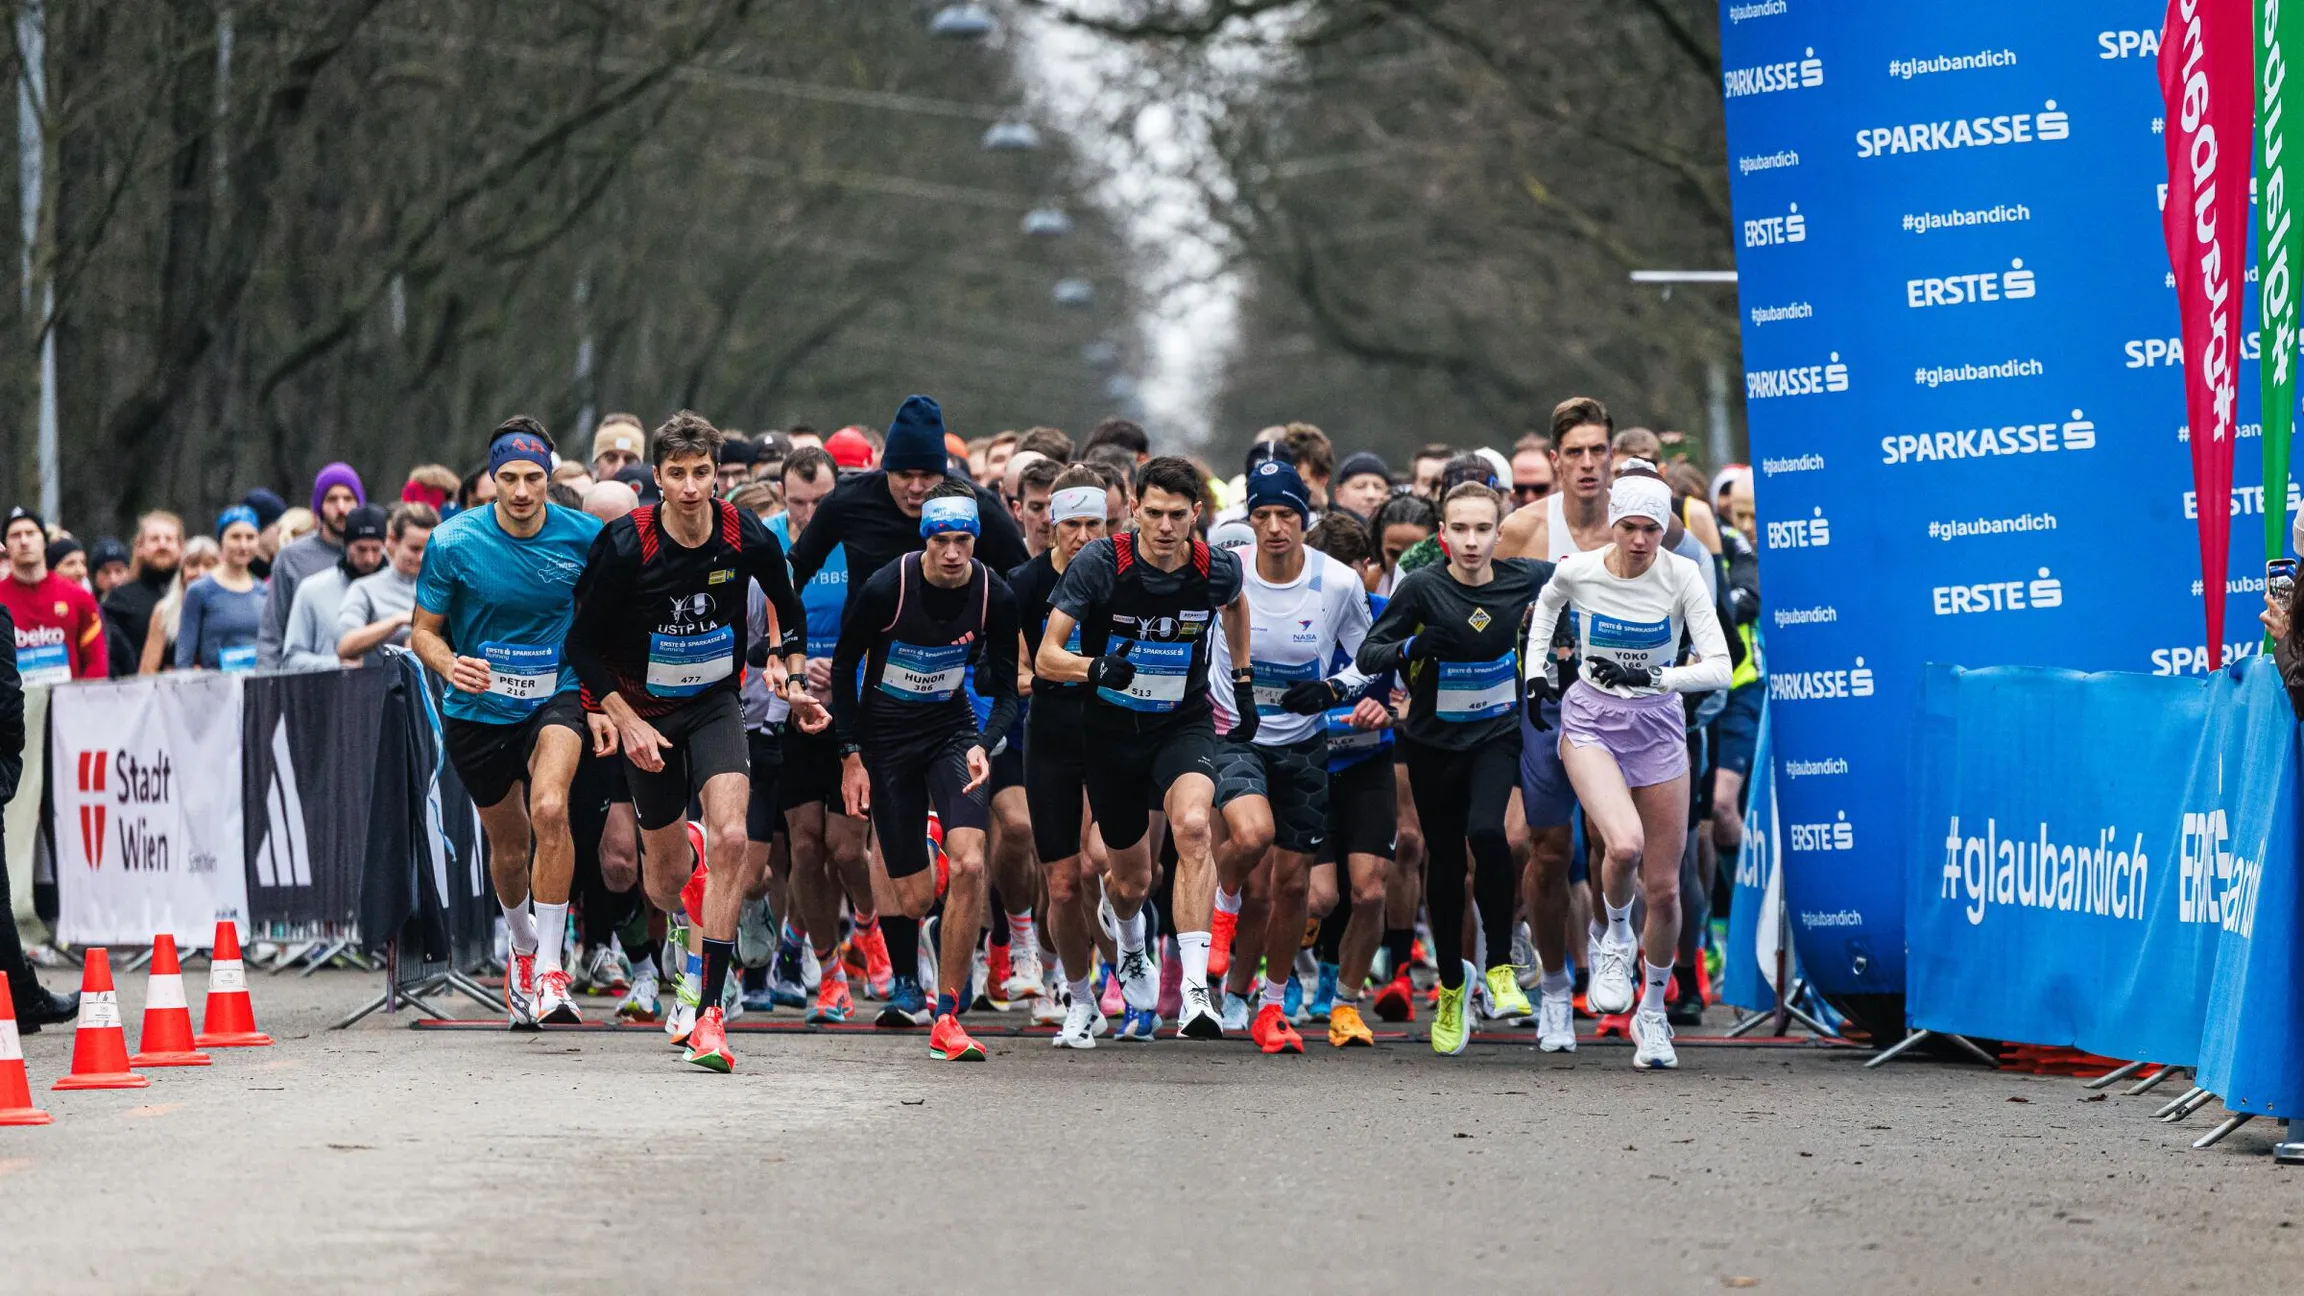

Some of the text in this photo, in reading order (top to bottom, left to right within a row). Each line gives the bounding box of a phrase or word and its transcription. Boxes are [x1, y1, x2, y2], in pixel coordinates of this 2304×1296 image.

[1730, 0, 1787, 24] #glaubandich
[1889, 49, 2017, 79] #glaubandich
[1724, 62, 1799, 98] SPARKASSE
[1856, 113, 2032, 158] SPARKASSE
[1739, 150, 1799, 176] #glaubandich
[1744, 216, 1784, 248] ERSTE
[1902, 204, 2030, 233] #glaubandich
[1907, 273, 2000, 308] ERSTE
[1751, 302, 1813, 327] #glaubandich
[1746, 365, 1823, 399] SPARKASSE
[1914, 359, 2043, 388] #glaubandich
[1881, 423, 2058, 465] SPARKASSE
[1762, 453, 1824, 478] #glaubandich
[1767, 519, 1808, 549] ERSTE
[1928, 513, 2057, 541] #glaubandich
[1933, 581, 2026, 615] ERSTE
[658, 620, 718, 635] USTP LA
[1774, 606, 1837, 629] #glaubandich
[1143, 647, 1178, 656] SPARKASSE
[1615, 651, 1648, 661] YOKO
[499, 676, 535, 688] PETER
[507, 687, 526, 696] 216
[904, 673, 945, 684] HUNOR
[914, 684, 933, 692] 386
[1132, 688, 1152, 697] 513
[1769, 670, 1848, 700] SPARKASSE
[116, 749, 171, 804] Stadt
[1785, 757, 1848, 779] #glaubandich
[118, 816, 169, 872] Wien
[1791, 823, 1832, 851] ERSTE
[1942, 815, 2149, 926] #glaubandich
